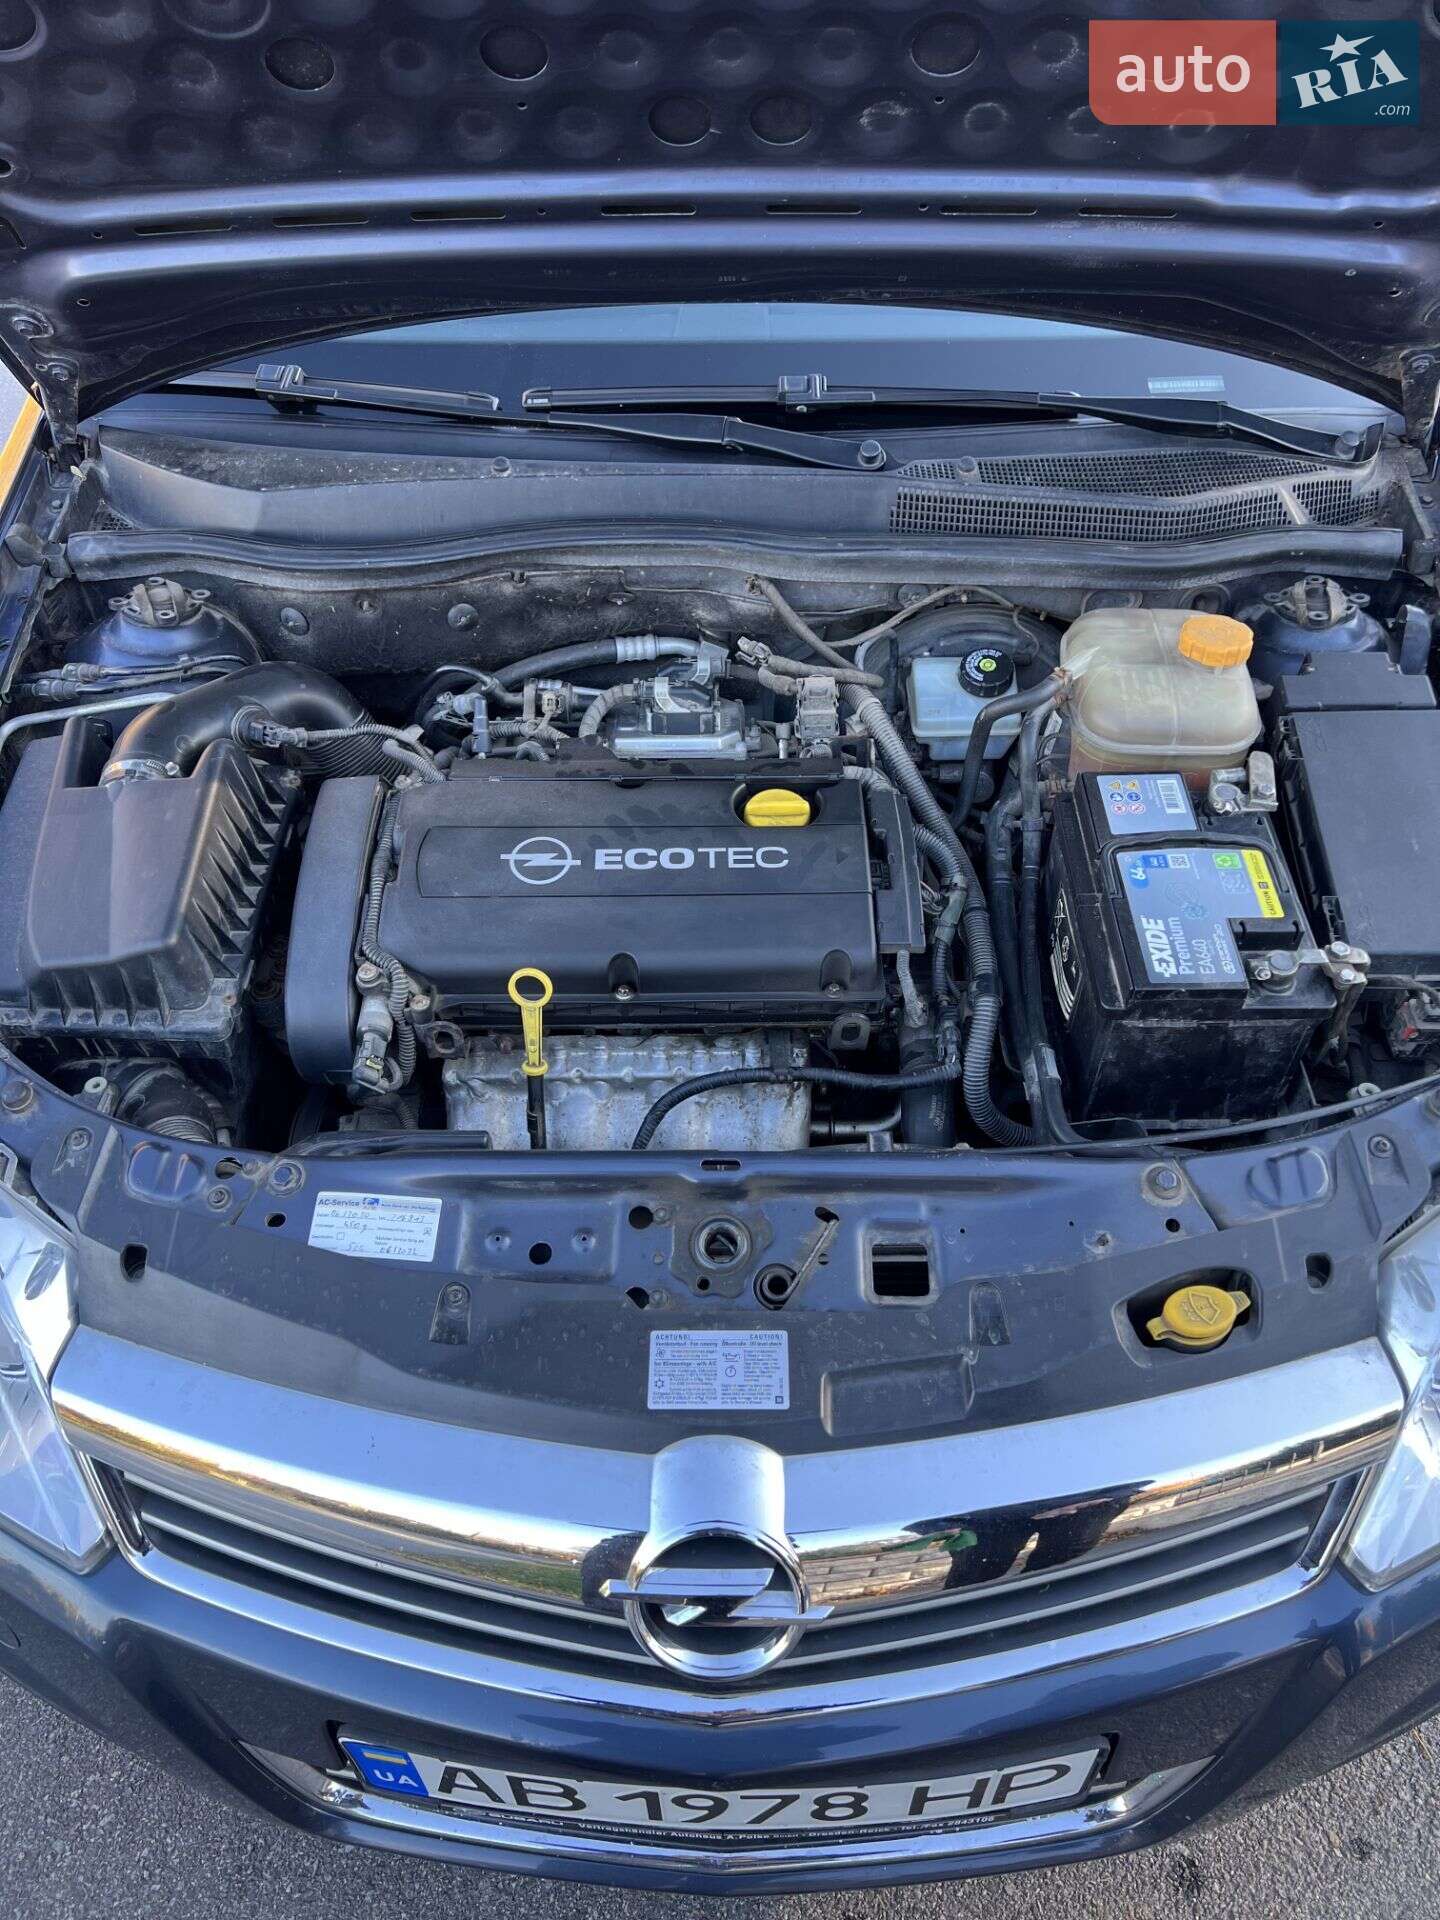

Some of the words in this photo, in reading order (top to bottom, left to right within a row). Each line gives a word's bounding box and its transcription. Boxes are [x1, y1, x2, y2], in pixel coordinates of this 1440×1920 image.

[594, 847, 789, 870] ECOTEC
[1141, 916, 1178, 978] EXIDE
[1168, 916, 1195, 976] Premium
[1191, 938, 1216, 975] EA640
[318, 1198, 360, 1207] AC-Service
[373, 1768, 418, 1787] UA
[437, 1766, 587, 1811] AB
[614, 1789, 869, 1824] 1978
[907, 1763, 1072, 1816] HP
